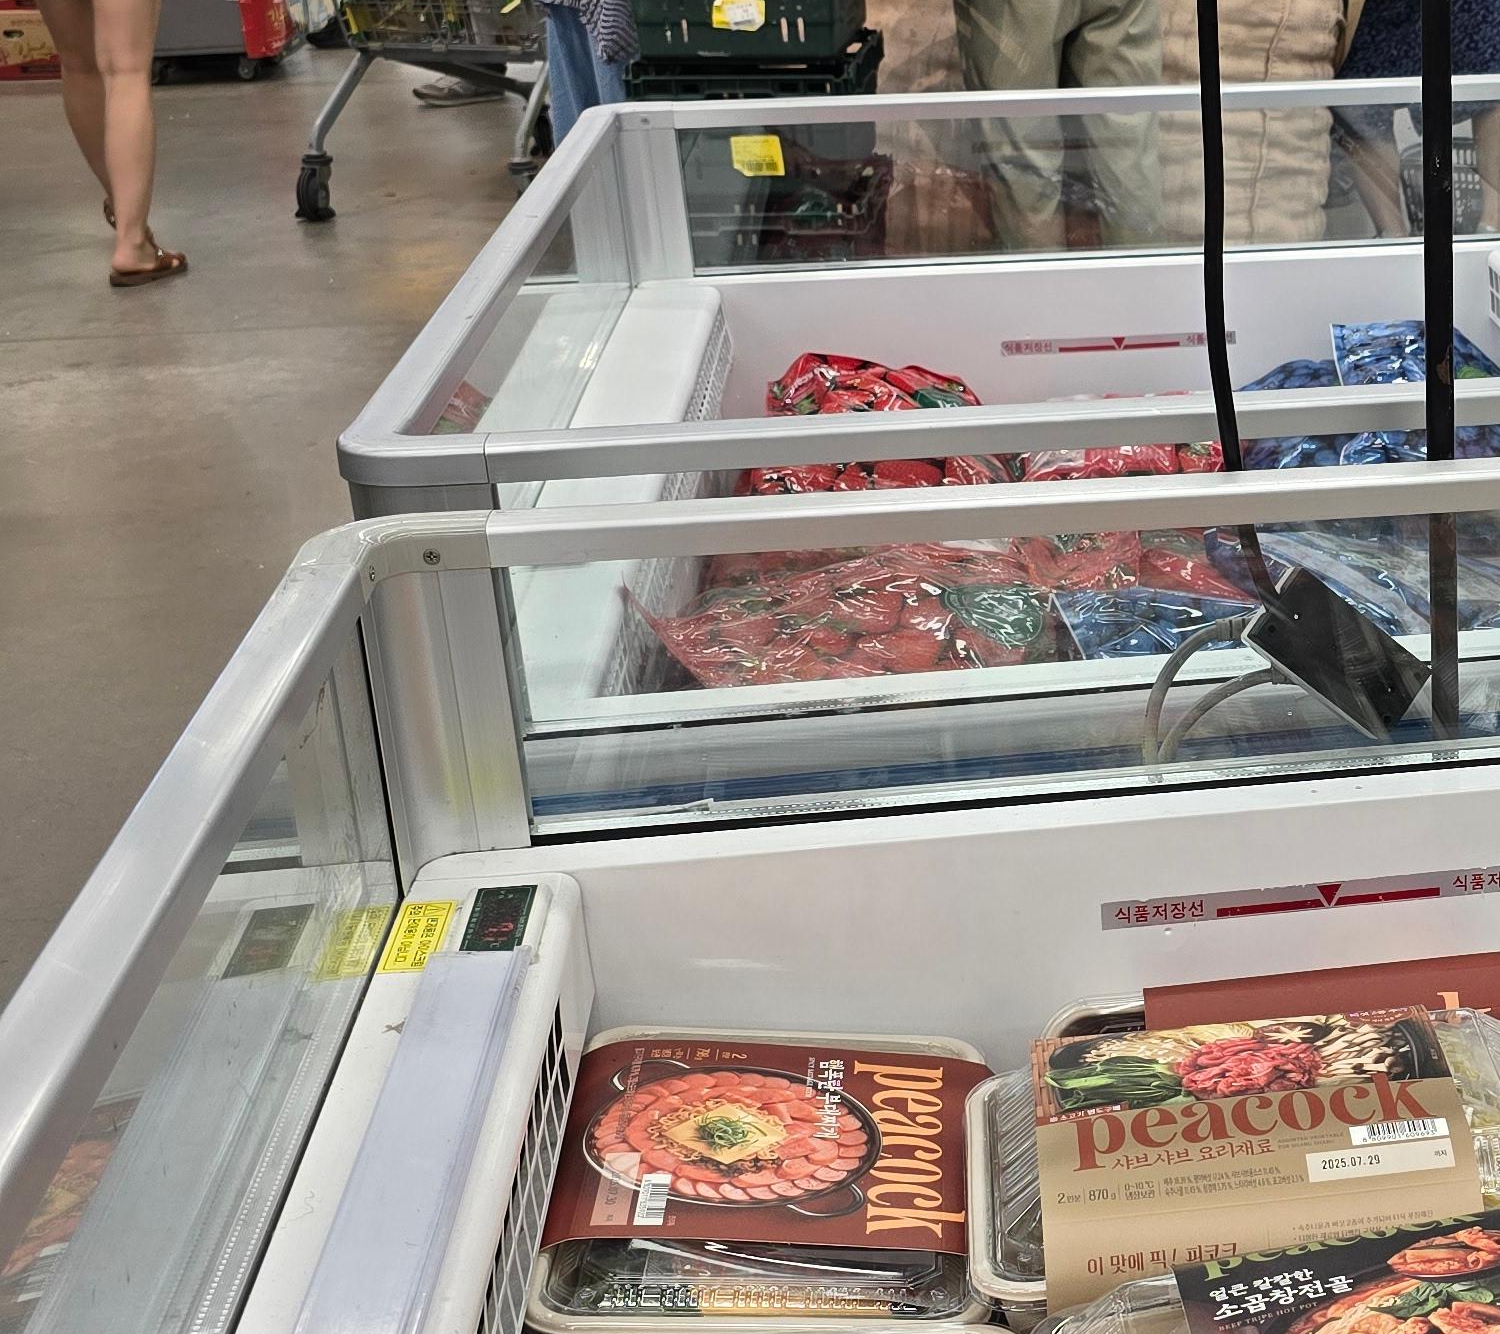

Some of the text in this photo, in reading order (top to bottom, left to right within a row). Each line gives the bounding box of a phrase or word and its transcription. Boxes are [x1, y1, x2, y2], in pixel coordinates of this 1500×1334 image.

[1115, 899, 1206, 925] 식품저장선
[813, 1059, 845, 1140] 햄폭탄 부대찌개
[1070, 1072, 1437, 1172] peacock
[854, 1060, 966, 1239] peacock
[1112, 1139, 1274, 1171] 샤브샤브 요리재료
[1322, 1154, 1381, 1170] 2025.07.29
[1088, 1242, 1238, 1276] 이 맛에 픽! 피코크
[1210, 1283, 1248, 1302] 얼큰
[1213, 1275, 1354, 1321] 소곱창전골
[1218, 1302, 1318, 1332] BEEF TRIPE HOT POT
